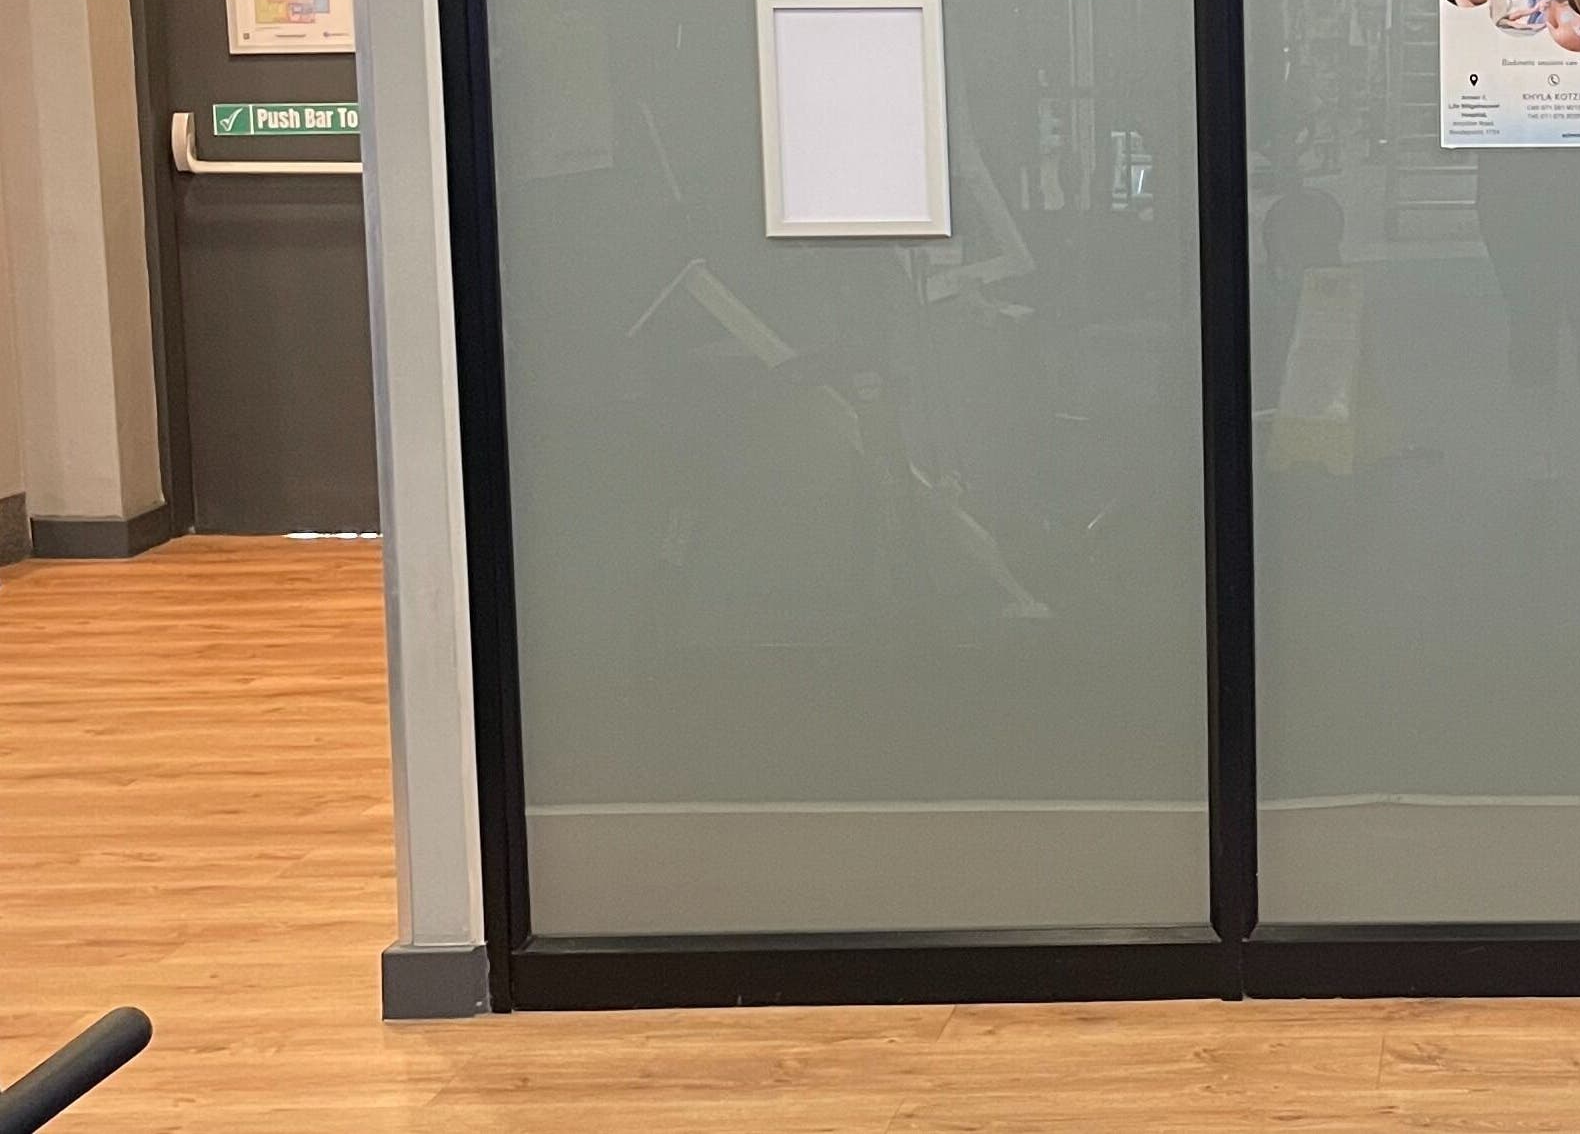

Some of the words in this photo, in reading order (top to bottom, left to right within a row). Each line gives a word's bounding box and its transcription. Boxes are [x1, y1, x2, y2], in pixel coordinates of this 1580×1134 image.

[256, 107, 301, 129] Push
[304, 107, 334, 129] Bar
[336, 107, 359, 129] To
